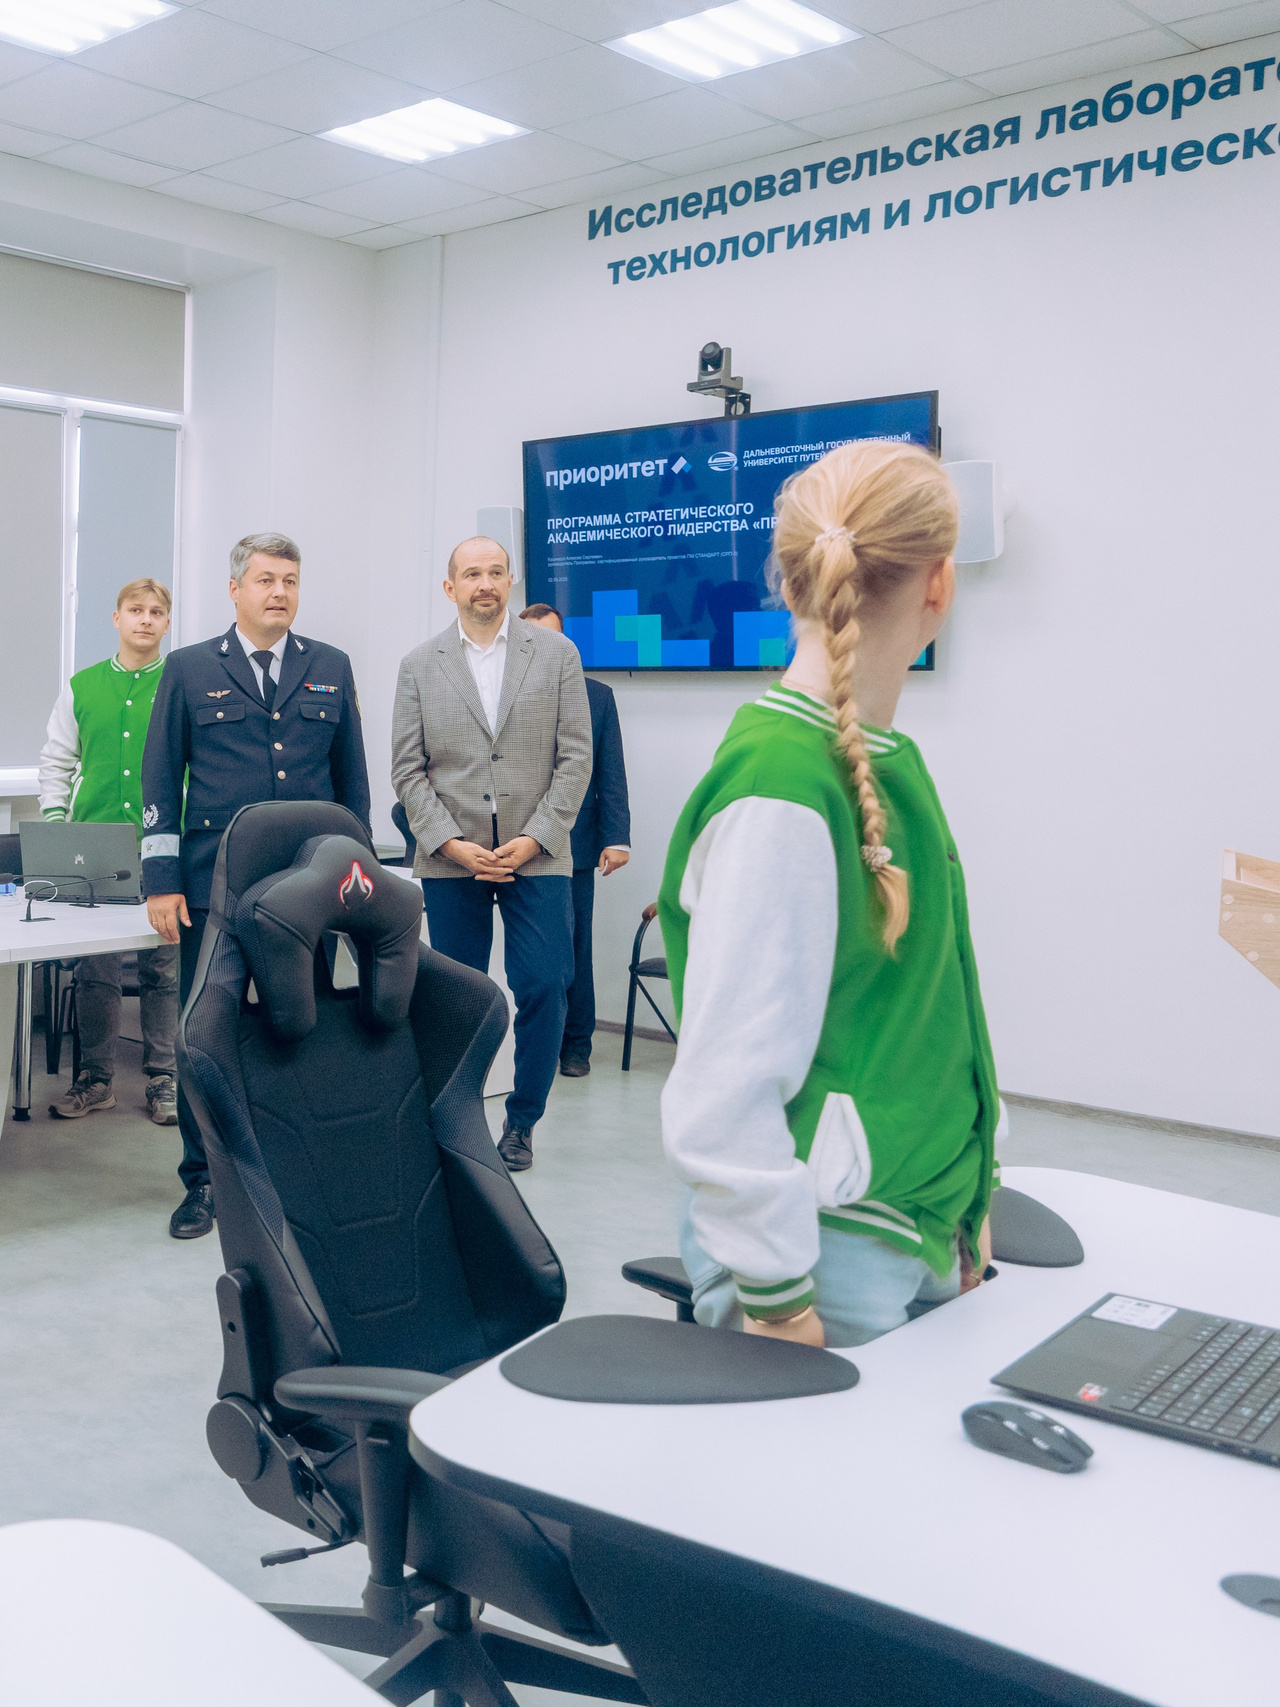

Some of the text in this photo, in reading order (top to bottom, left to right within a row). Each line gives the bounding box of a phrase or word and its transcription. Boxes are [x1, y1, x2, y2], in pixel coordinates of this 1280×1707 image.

[588, 57, 1280, 241] Исследовательская лаборат
[607, 122, 1280, 285] технологиям и логистическ
[743, 440, 825, 459] ДАЛЬНЕВОСТОЧНЫЙ
[743, 454, 799, 468] УНИВЕРСИТЕТ
[545, 459, 668, 490] приоритет
[547, 502, 754, 530] ПРОГРАММА СТРАТЕГИЧЕСКОГО
[547, 516, 780, 544] АКАДЕМИЧЕСКОГО ЛИДЕРСТВА «ПР
